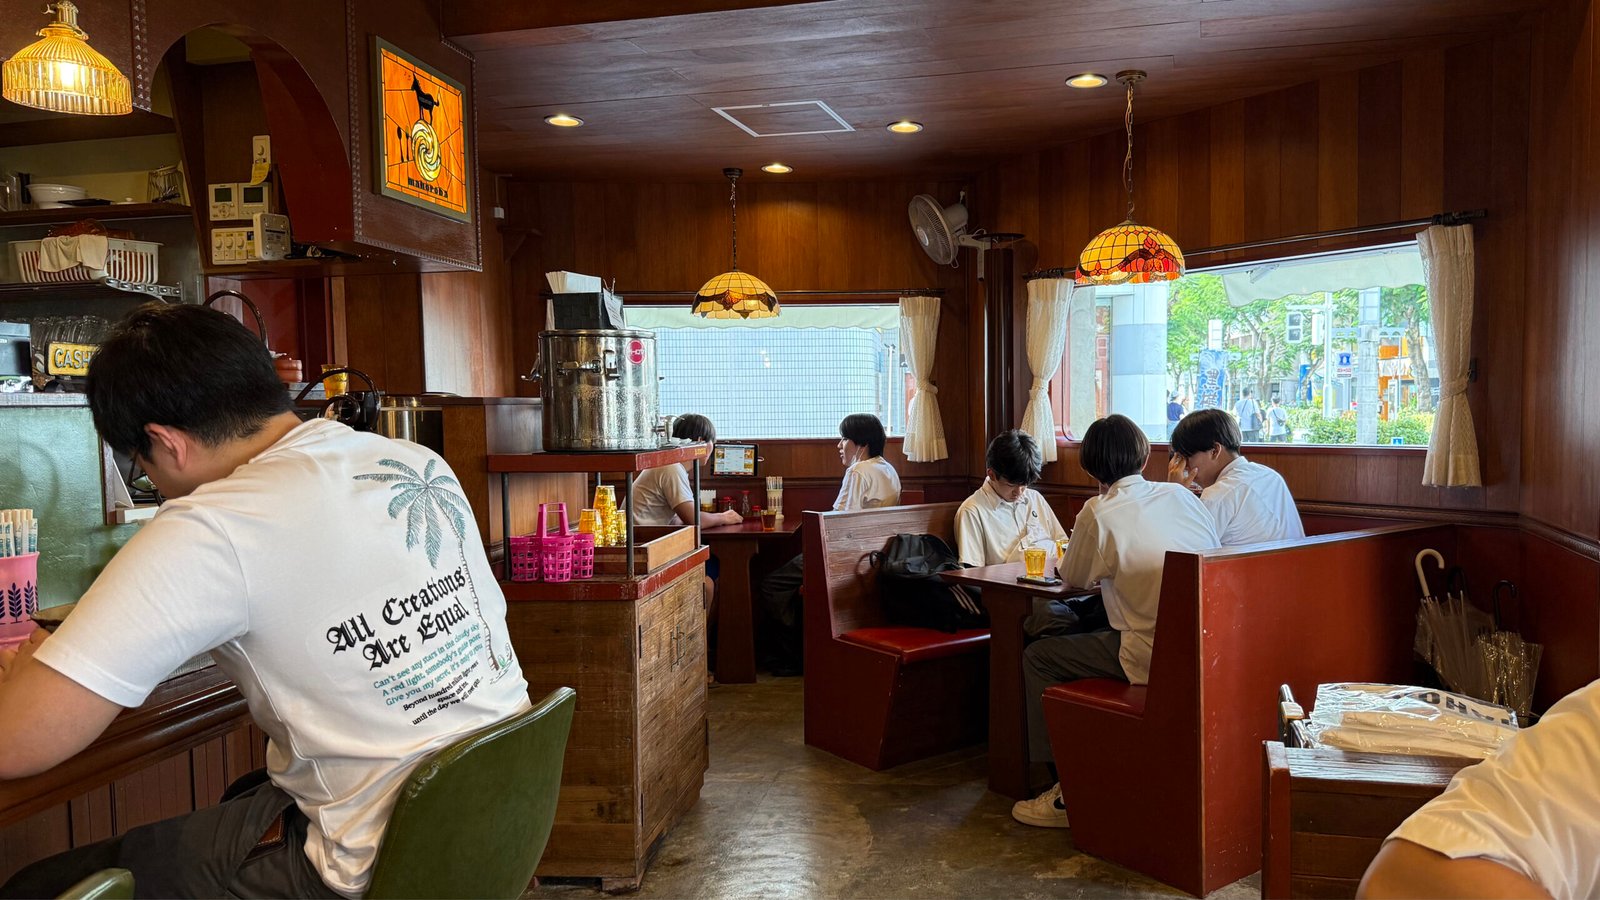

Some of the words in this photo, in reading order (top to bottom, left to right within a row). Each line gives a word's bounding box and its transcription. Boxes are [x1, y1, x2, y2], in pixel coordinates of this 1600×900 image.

[326, 612, 376, 655] All
[382, 566, 467, 626] Creations
[362, 633, 412, 672] Are
[416, 594, 470, 645] Equal
[373, 674, 396, 689] Can't
[396, 667, 411, 679] see
[411, 661, 424, 673] any
[422, 651, 438, 664] stars
[438, 646, 445, 655] in
[445, 640, 454, 650] the
[382, 689, 390, 697] A
[390, 682, 405, 694] red
[425, 650, 458, 675] somebody's
[385, 692, 407, 706] Give
[405, 686, 422, 698] you
[422, 679, 435, 692] my
[402, 694, 428, 712] Beyond
[427, 682, 454, 701] hundred
[411, 711, 428, 725] until
[426, 707, 438, 717] the
[437, 701, 450, 711] day
[449, 698, 461, 706] we
[437, 691, 456, 703] space
